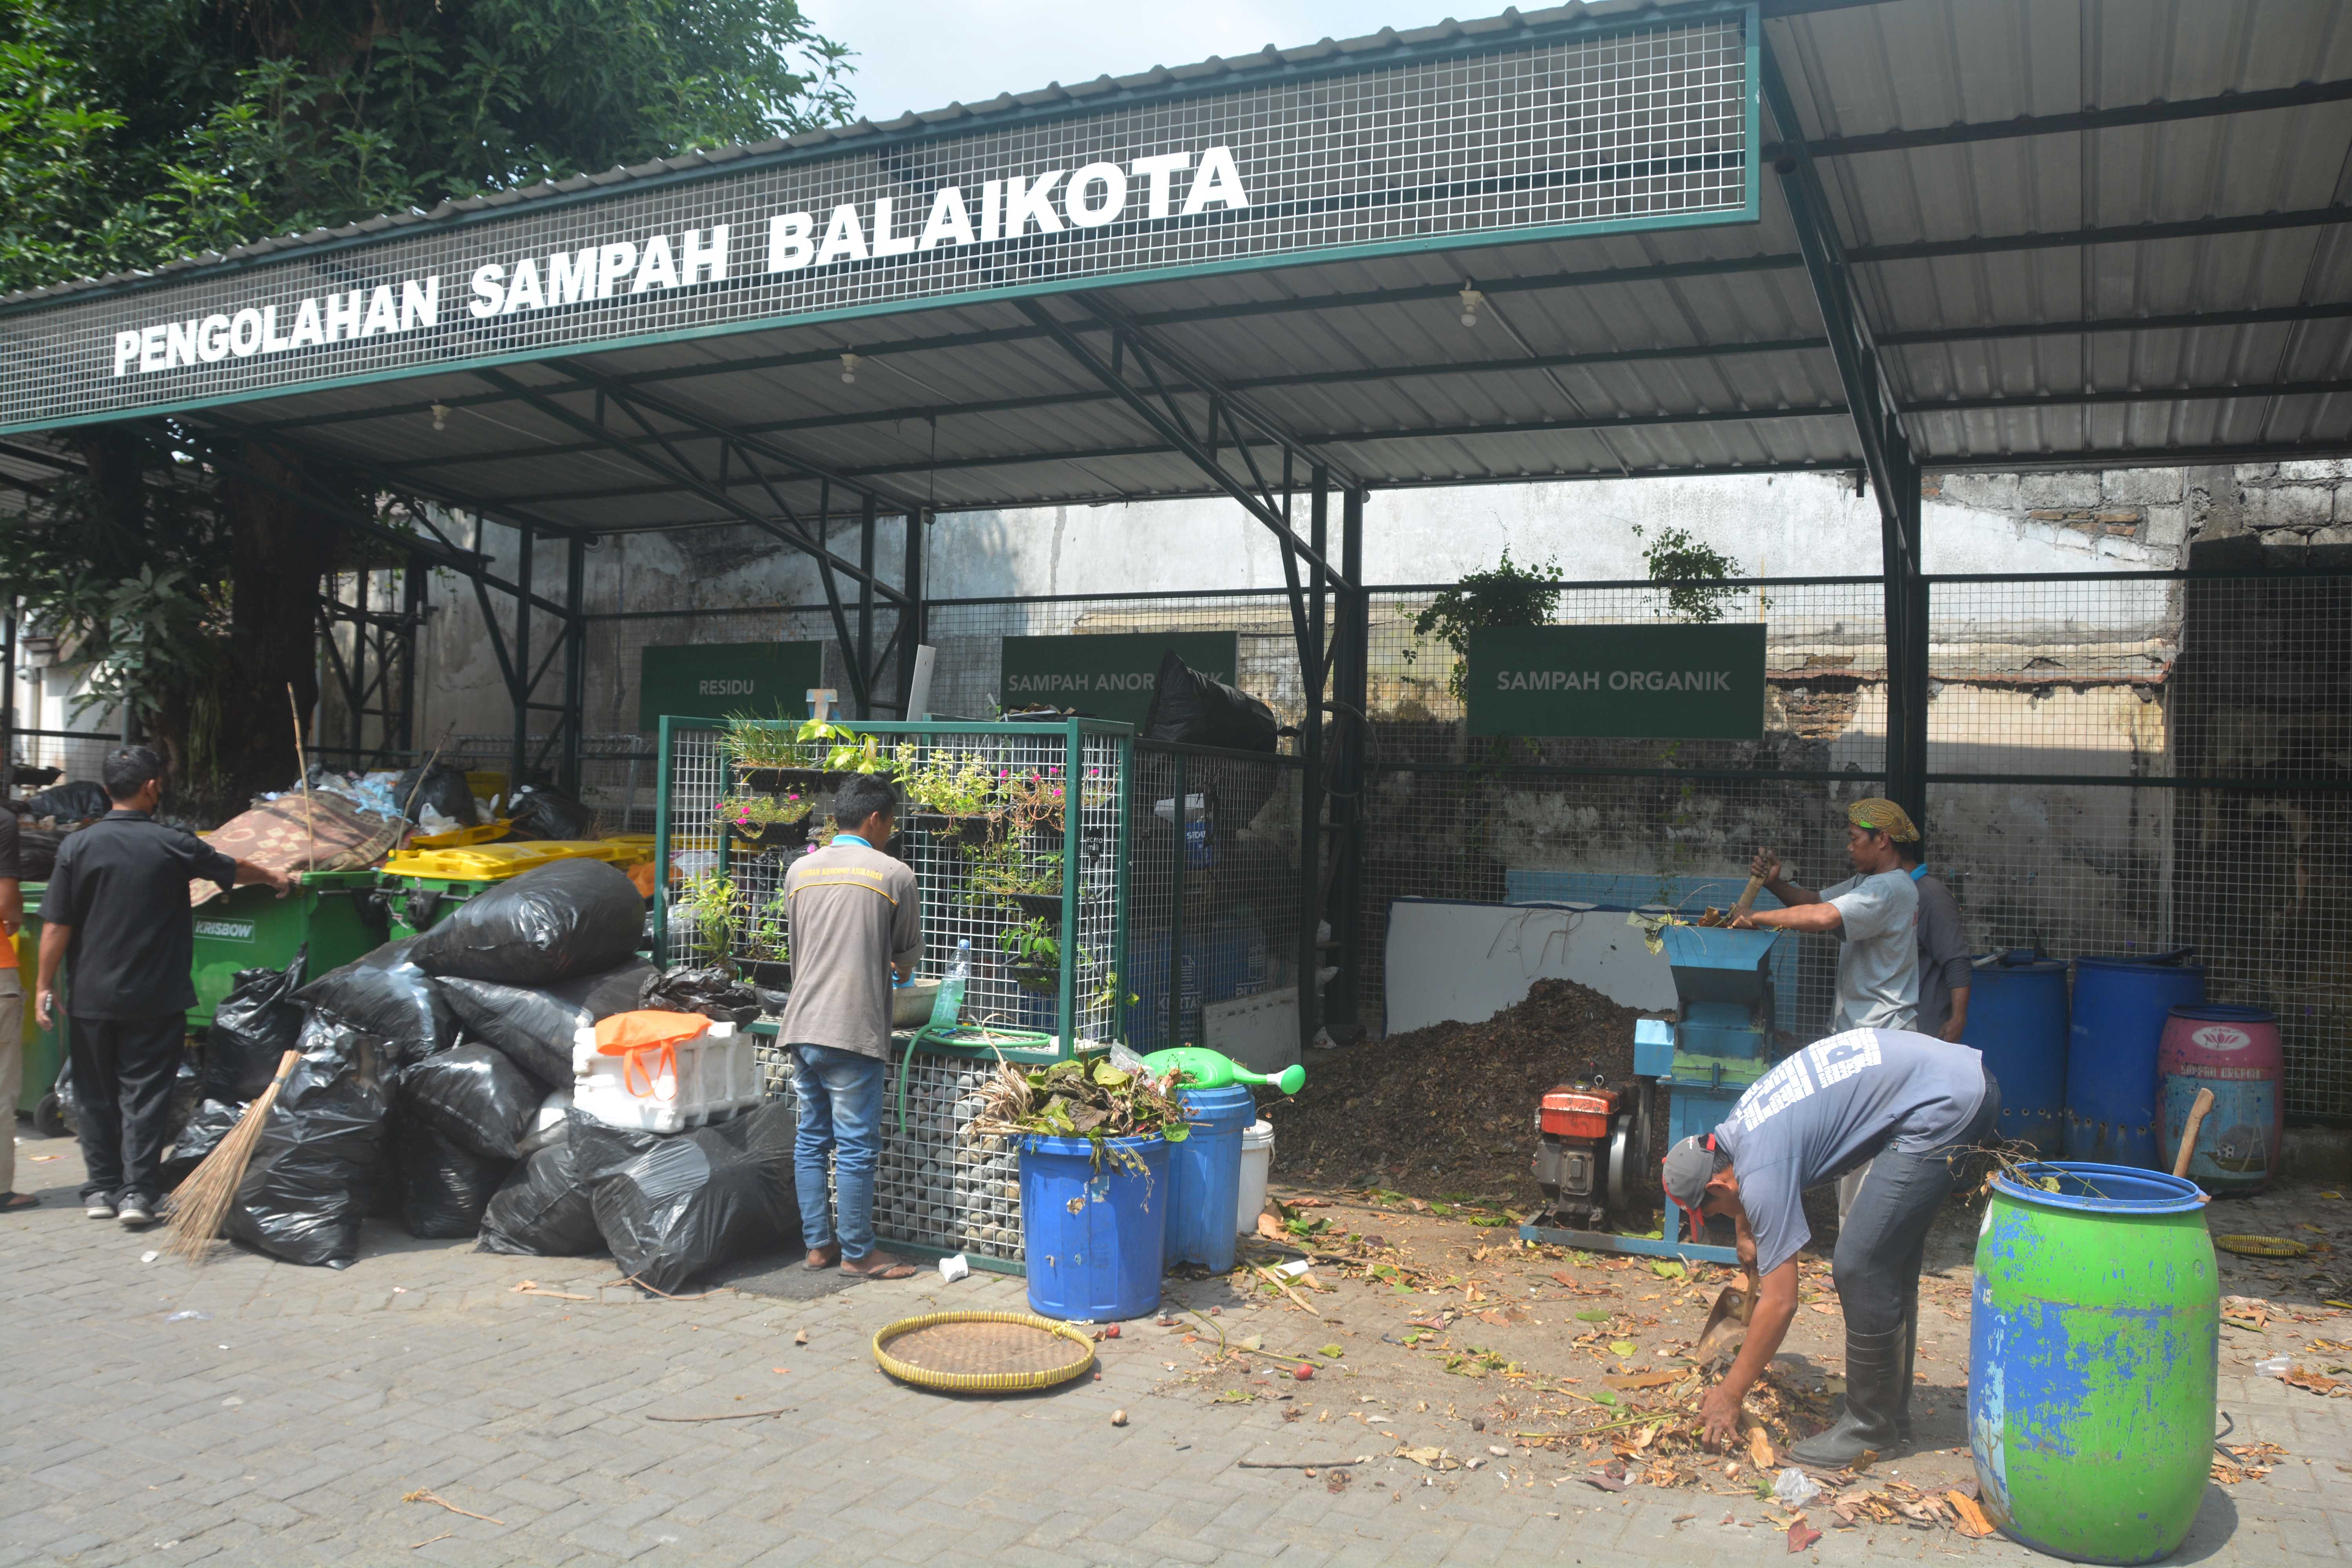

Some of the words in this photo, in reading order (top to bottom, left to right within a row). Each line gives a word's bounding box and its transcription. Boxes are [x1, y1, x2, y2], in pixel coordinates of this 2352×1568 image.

[114, 275, 439, 377] PENGOLAHAN
[469, 224, 729, 319] SAMPAH
[767, 145, 1249, 274] BALAIKOTA
[699, 679, 753, 695] RESIDU
[1009, 674, 1088, 691] SAMPAH
[1497, 671, 1599, 690] SAMPAH
[1608, 671, 1731, 690] ORGANIK
[195, 921, 252, 937] KRISBOW
